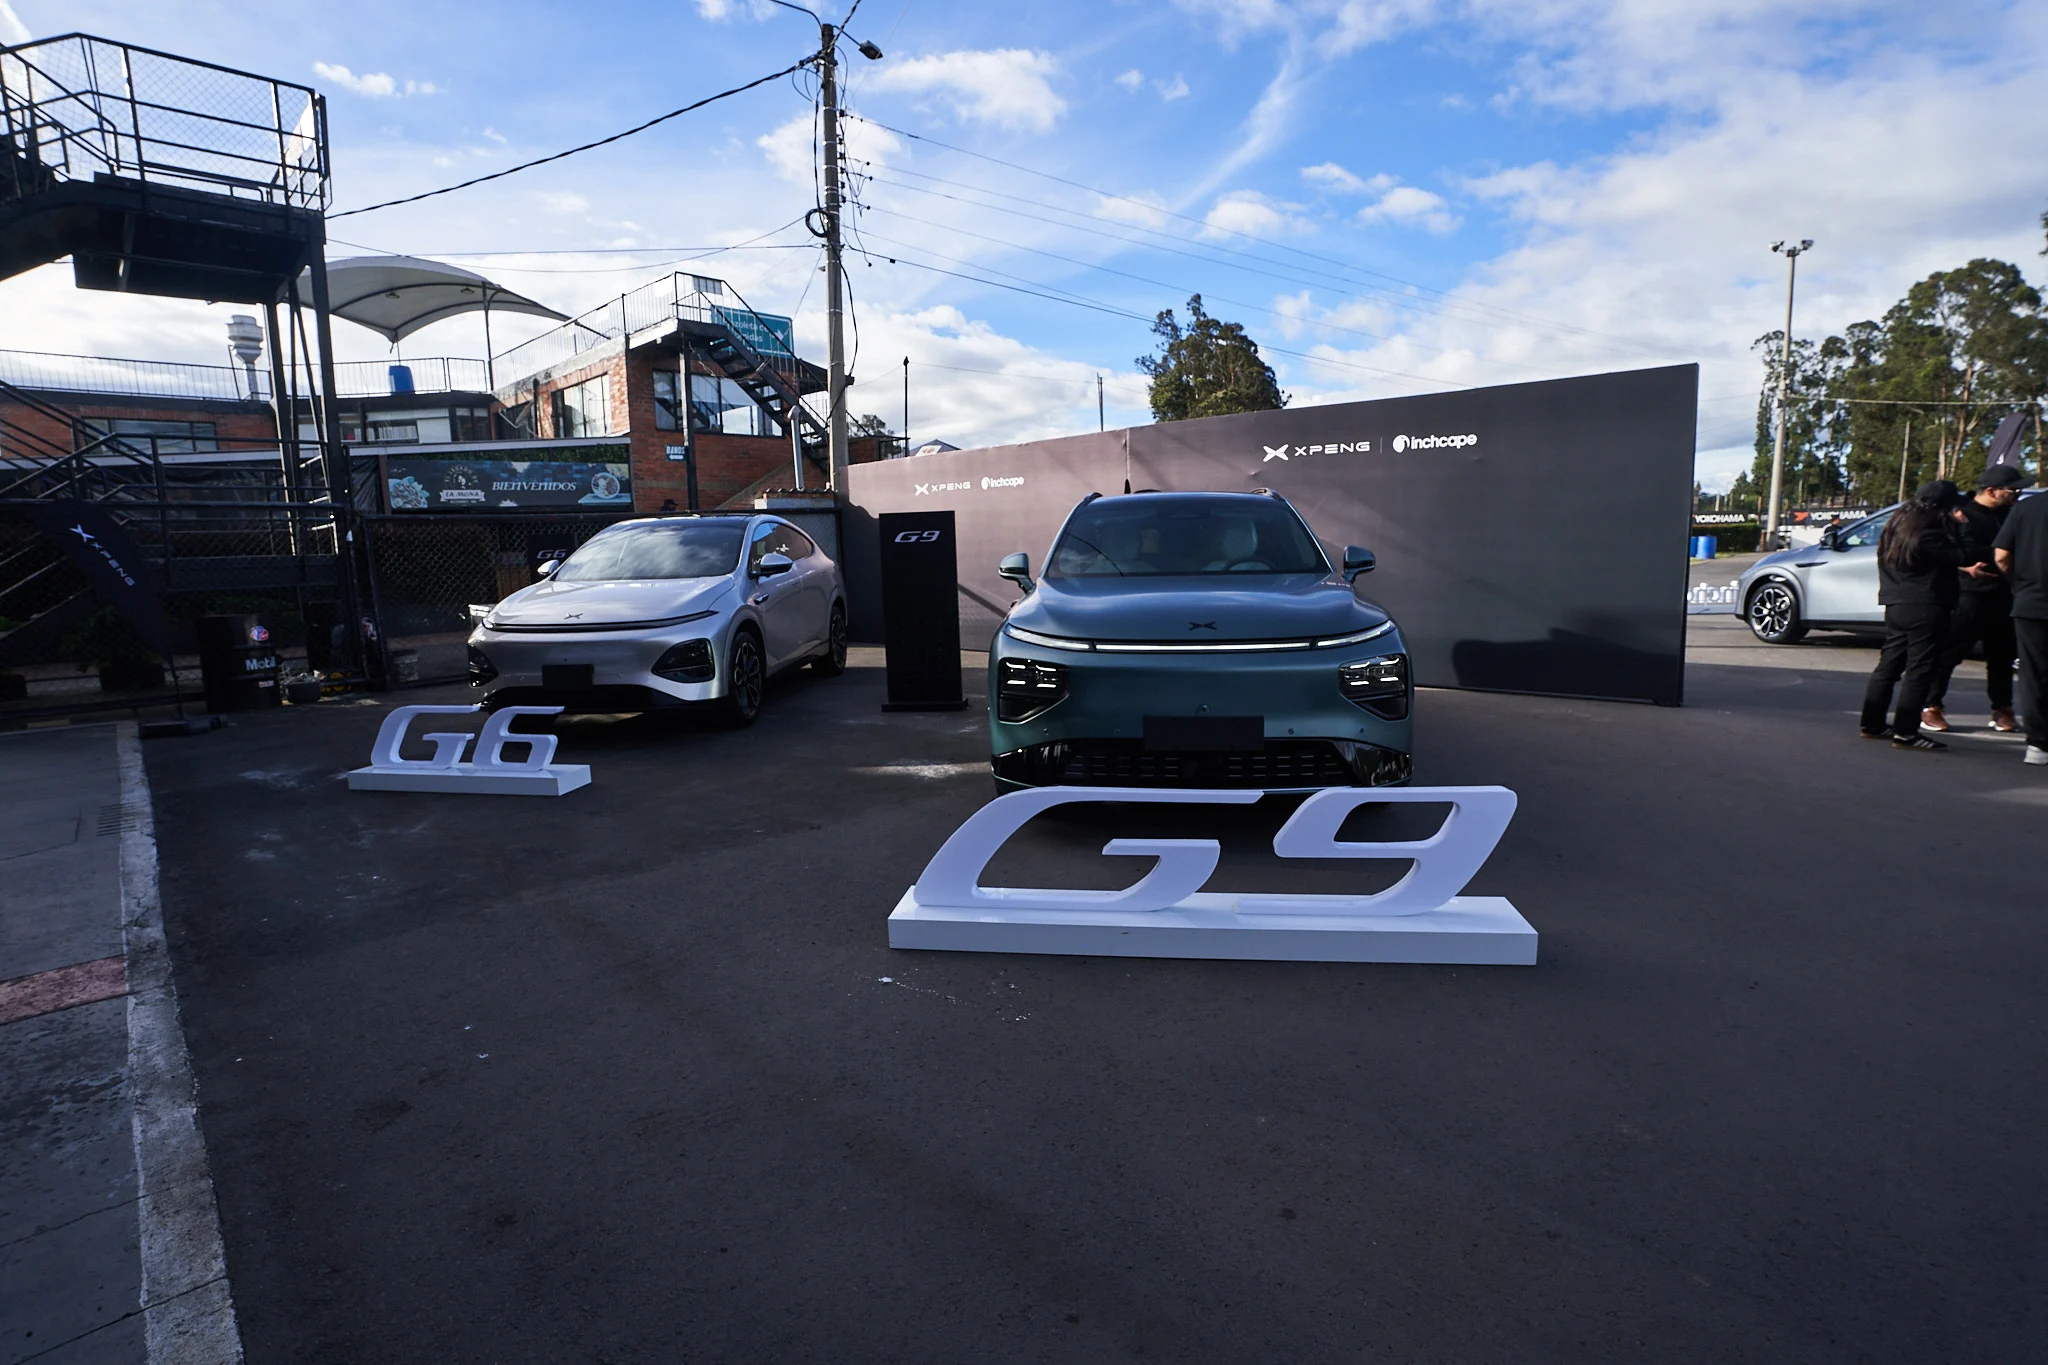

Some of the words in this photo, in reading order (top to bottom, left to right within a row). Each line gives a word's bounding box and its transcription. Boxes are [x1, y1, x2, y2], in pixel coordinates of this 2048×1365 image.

[1294, 441, 1371, 457] XPENG
[1411, 433, 1478, 450] inchcape
[492, 481, 577, 491] BIENVENIDOS
[931, 481, 971, 492] XPENG
[990, 476, 1025, 488] inchcape
[1695, 513, 1745, 524] YOKOHAMA
[894, 530, 940, 543] G9
[537, 549, 567, 559] G6
[91, 542, 136, 587] XPENG
[245, 656, 276, 671] Mobil
[370, 704, 566, 773] G6
[913, 785, 1518, 917] G9
